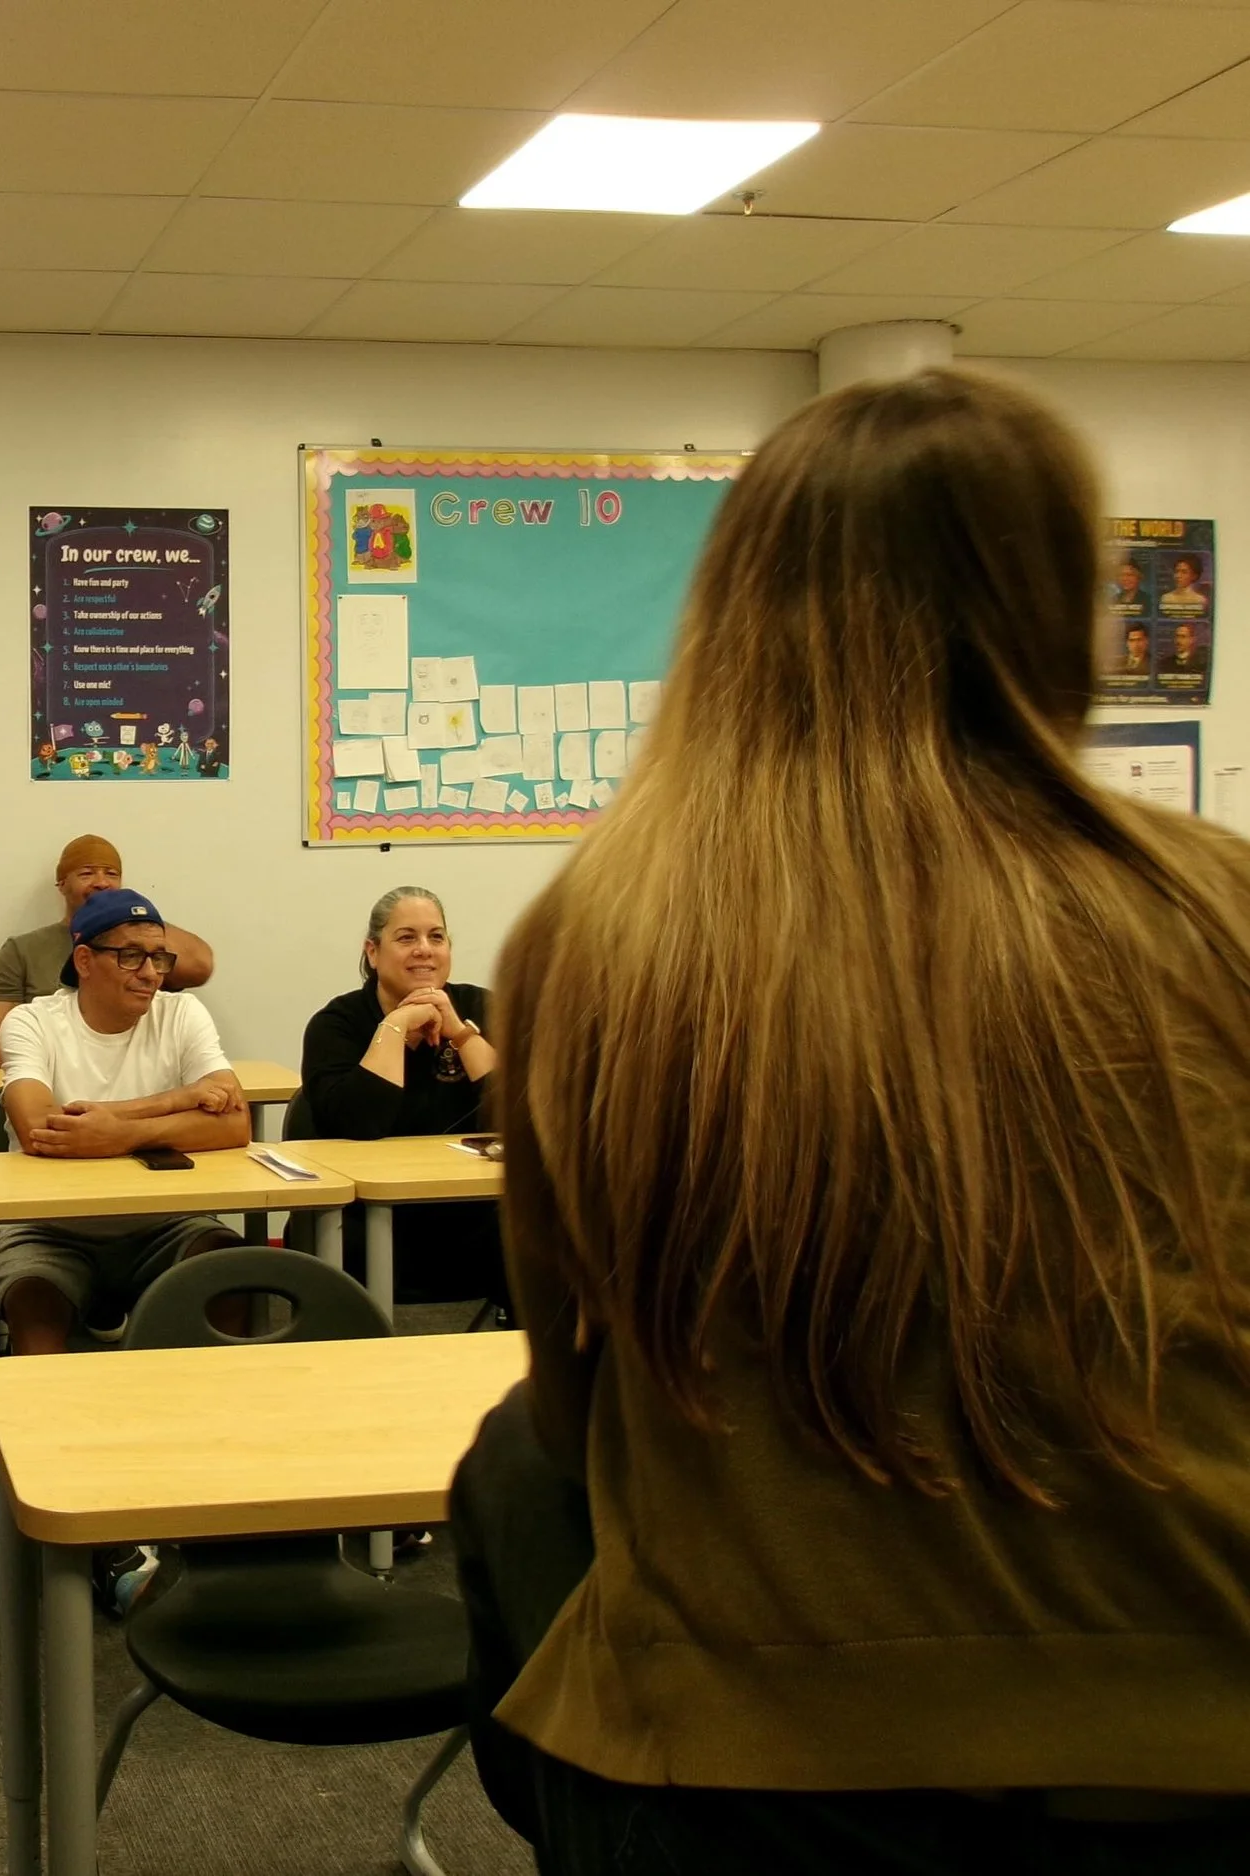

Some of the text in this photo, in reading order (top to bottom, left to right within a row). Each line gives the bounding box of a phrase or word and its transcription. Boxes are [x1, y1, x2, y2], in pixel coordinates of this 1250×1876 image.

[430, 491, 554, 526] Crew
[61, 545, 79, 562] In
[83, 549, 112, 562] our
[116, 549, 161, 564] crew,
[74, 578, 88, 586] Have
[89, 578, 99, 586] fun
[100, 579, 111, 587] and
[112, 579, 129, 588] party
[74, 611, 88, 619] Take
[89, 612, 120, 620] ownership
[90, 645, 105, 653] there
[116, 645, 129, 653] time
[140, 646, 154, 654] place
[164, 646, 194, 654] everything
[74, 681, 85, 689] Use
[98, 681, 111, 689] mic!
